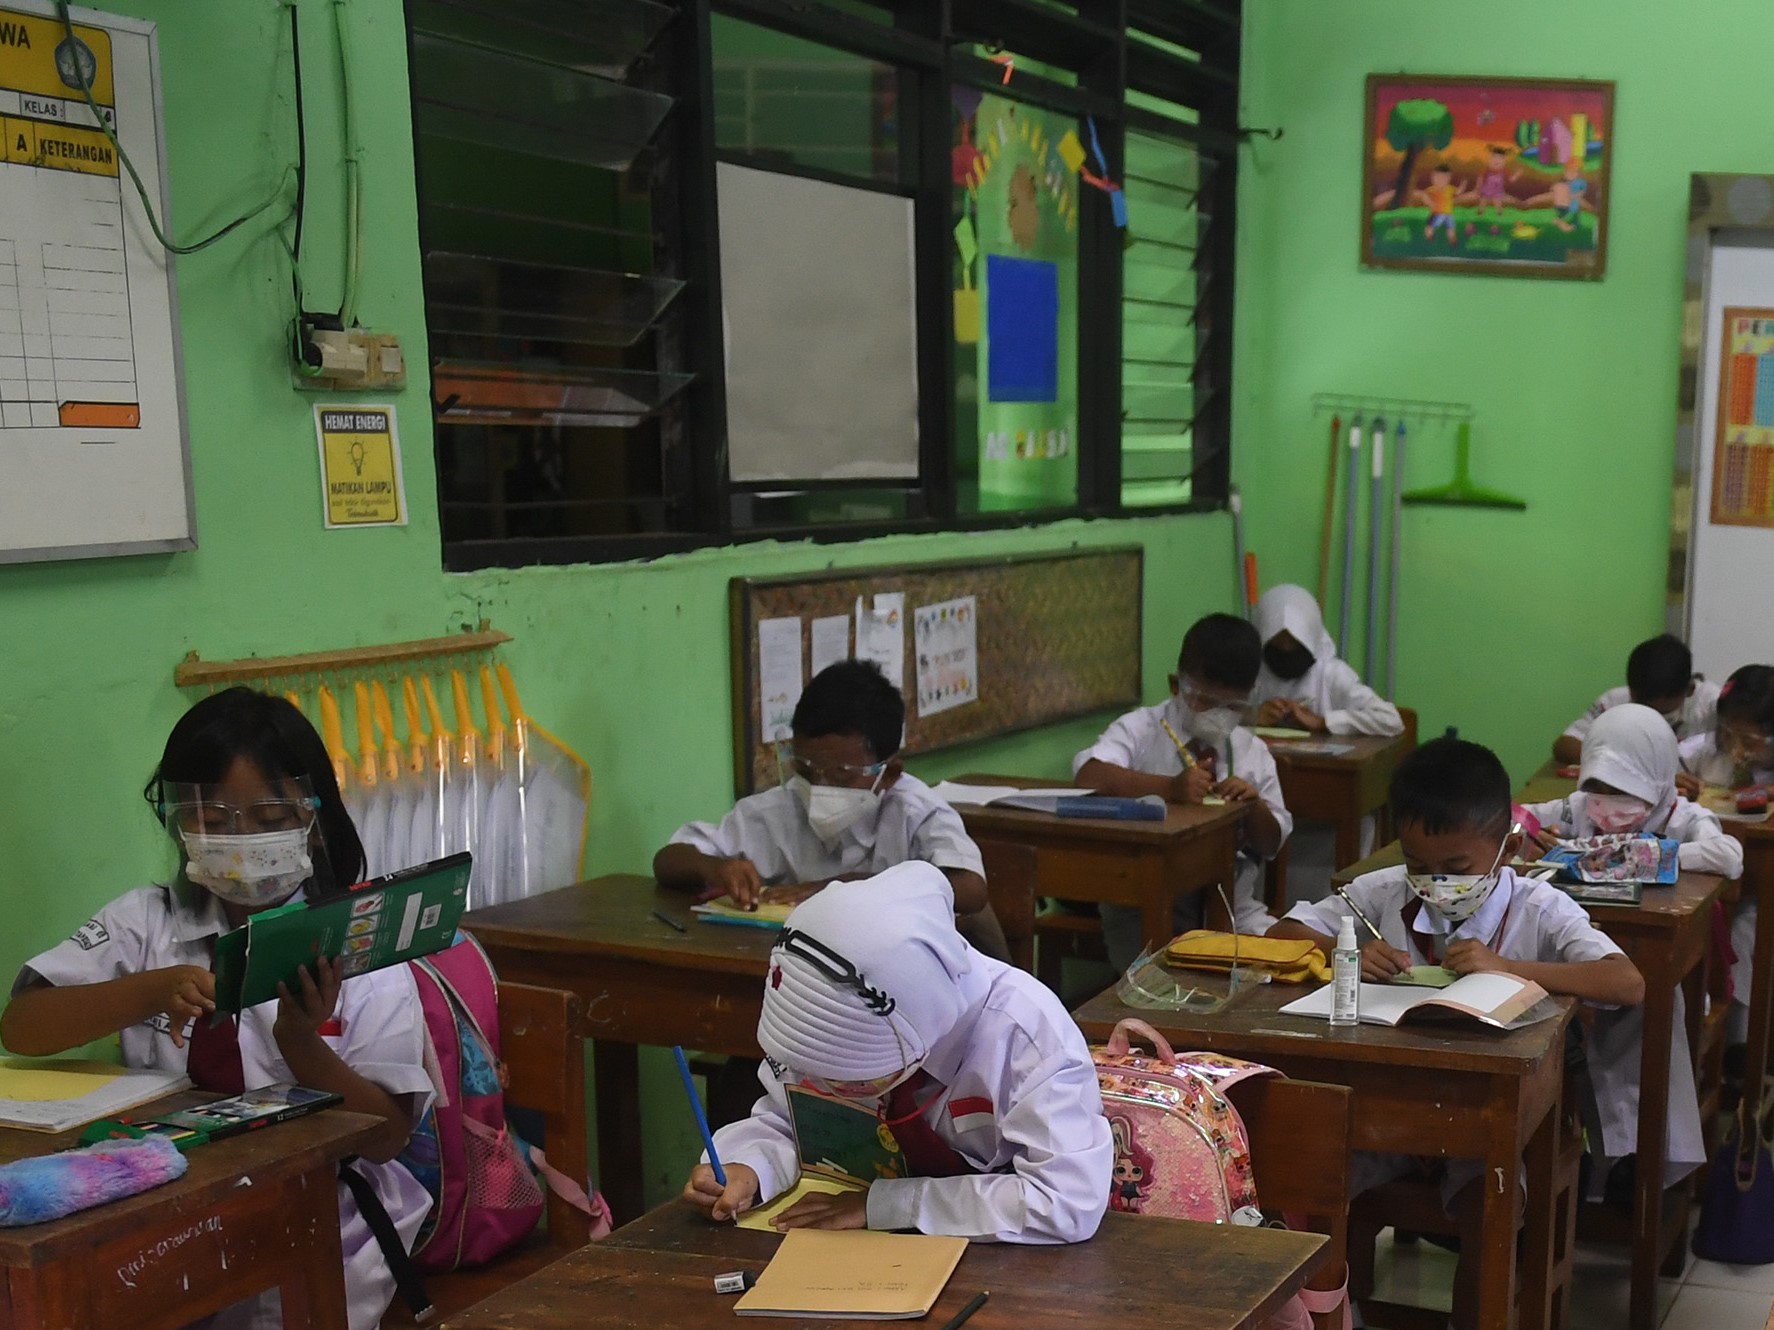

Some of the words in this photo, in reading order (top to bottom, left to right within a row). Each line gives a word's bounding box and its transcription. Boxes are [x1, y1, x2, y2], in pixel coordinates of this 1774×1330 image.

[24, 100, 57, 117] KELAS
[16, 134, 27, 152] A
[40, 138, 112, 164] KETERANGAN
[325, 415, 354, 429] HEMAT
[356, 415, 386, 430] ENERGI
[331, 482, 363, 494] MATIKAN
[366, 481, 391, 494] LAMPU
